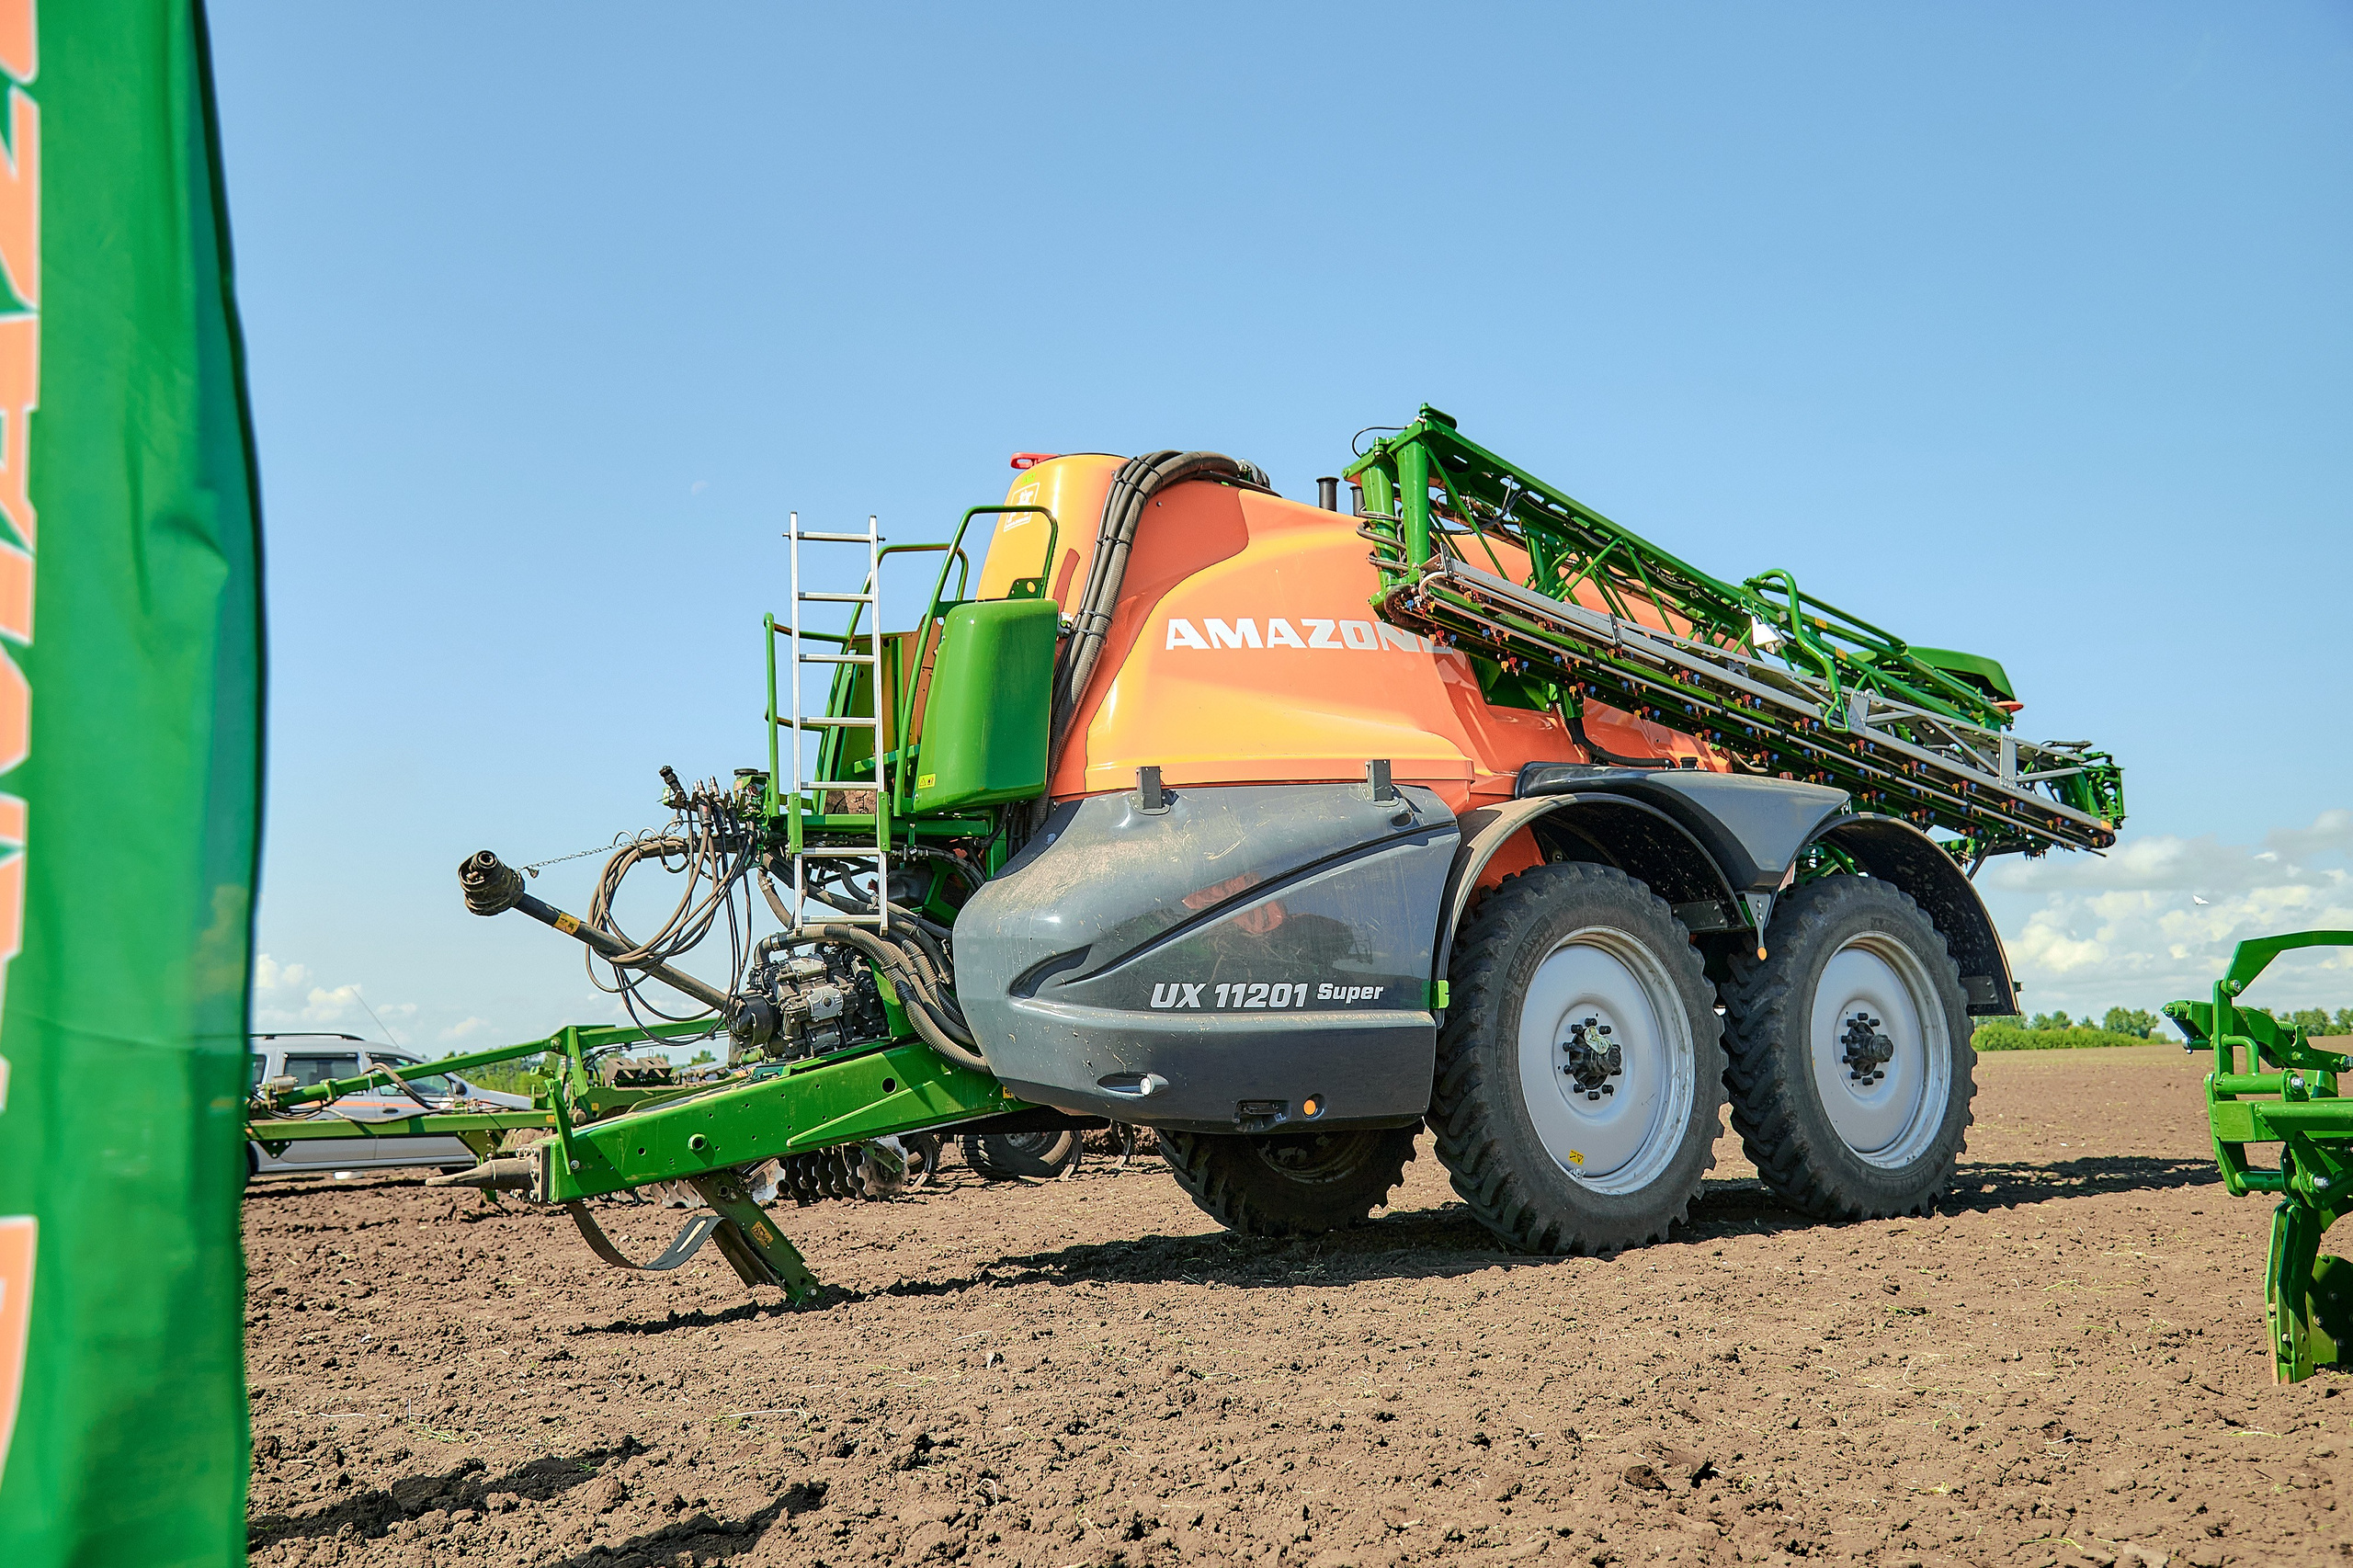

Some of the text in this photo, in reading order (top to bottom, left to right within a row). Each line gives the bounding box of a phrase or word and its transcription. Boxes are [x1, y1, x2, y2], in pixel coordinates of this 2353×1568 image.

[1150, 983, 1384, 1008] UX 11201 Super
